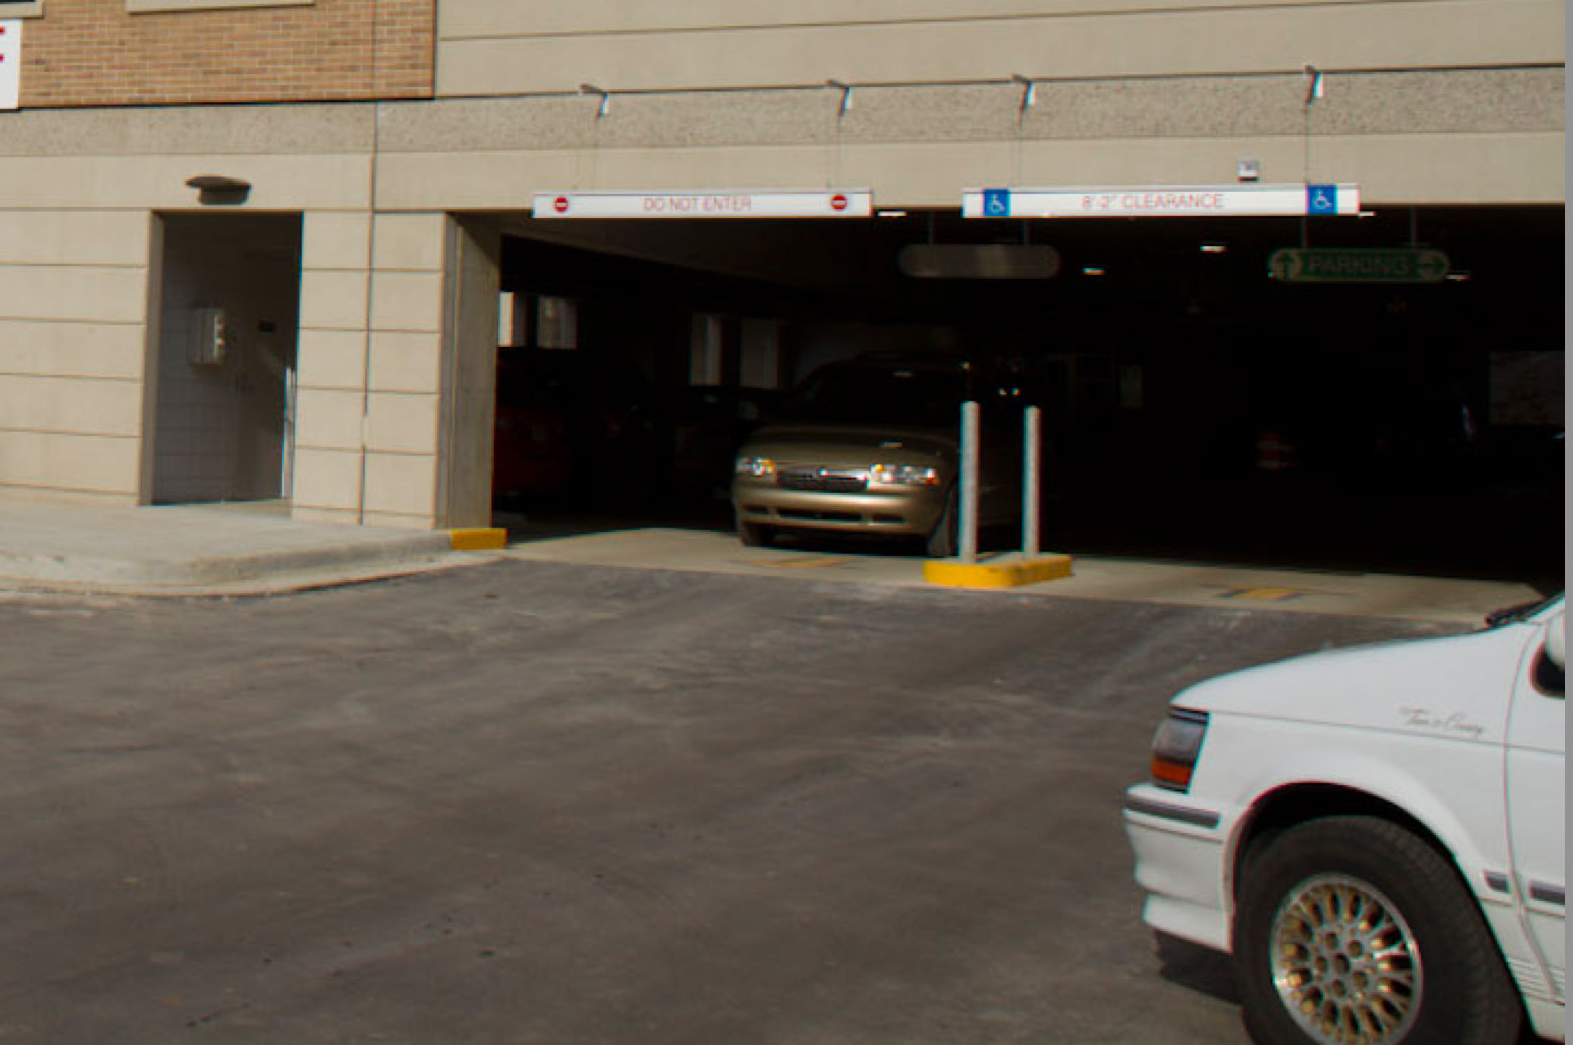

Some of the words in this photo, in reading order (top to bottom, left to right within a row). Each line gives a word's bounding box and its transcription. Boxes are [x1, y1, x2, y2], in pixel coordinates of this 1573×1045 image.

[642, 196, 665, 212] DO
[669, 196, 698, 212] NOT
[702, 195, 752, 211] ENTER
[1121, 192, 1225, 209] CLEARANCE
[1308, 254, 1409, 275] PARKING
